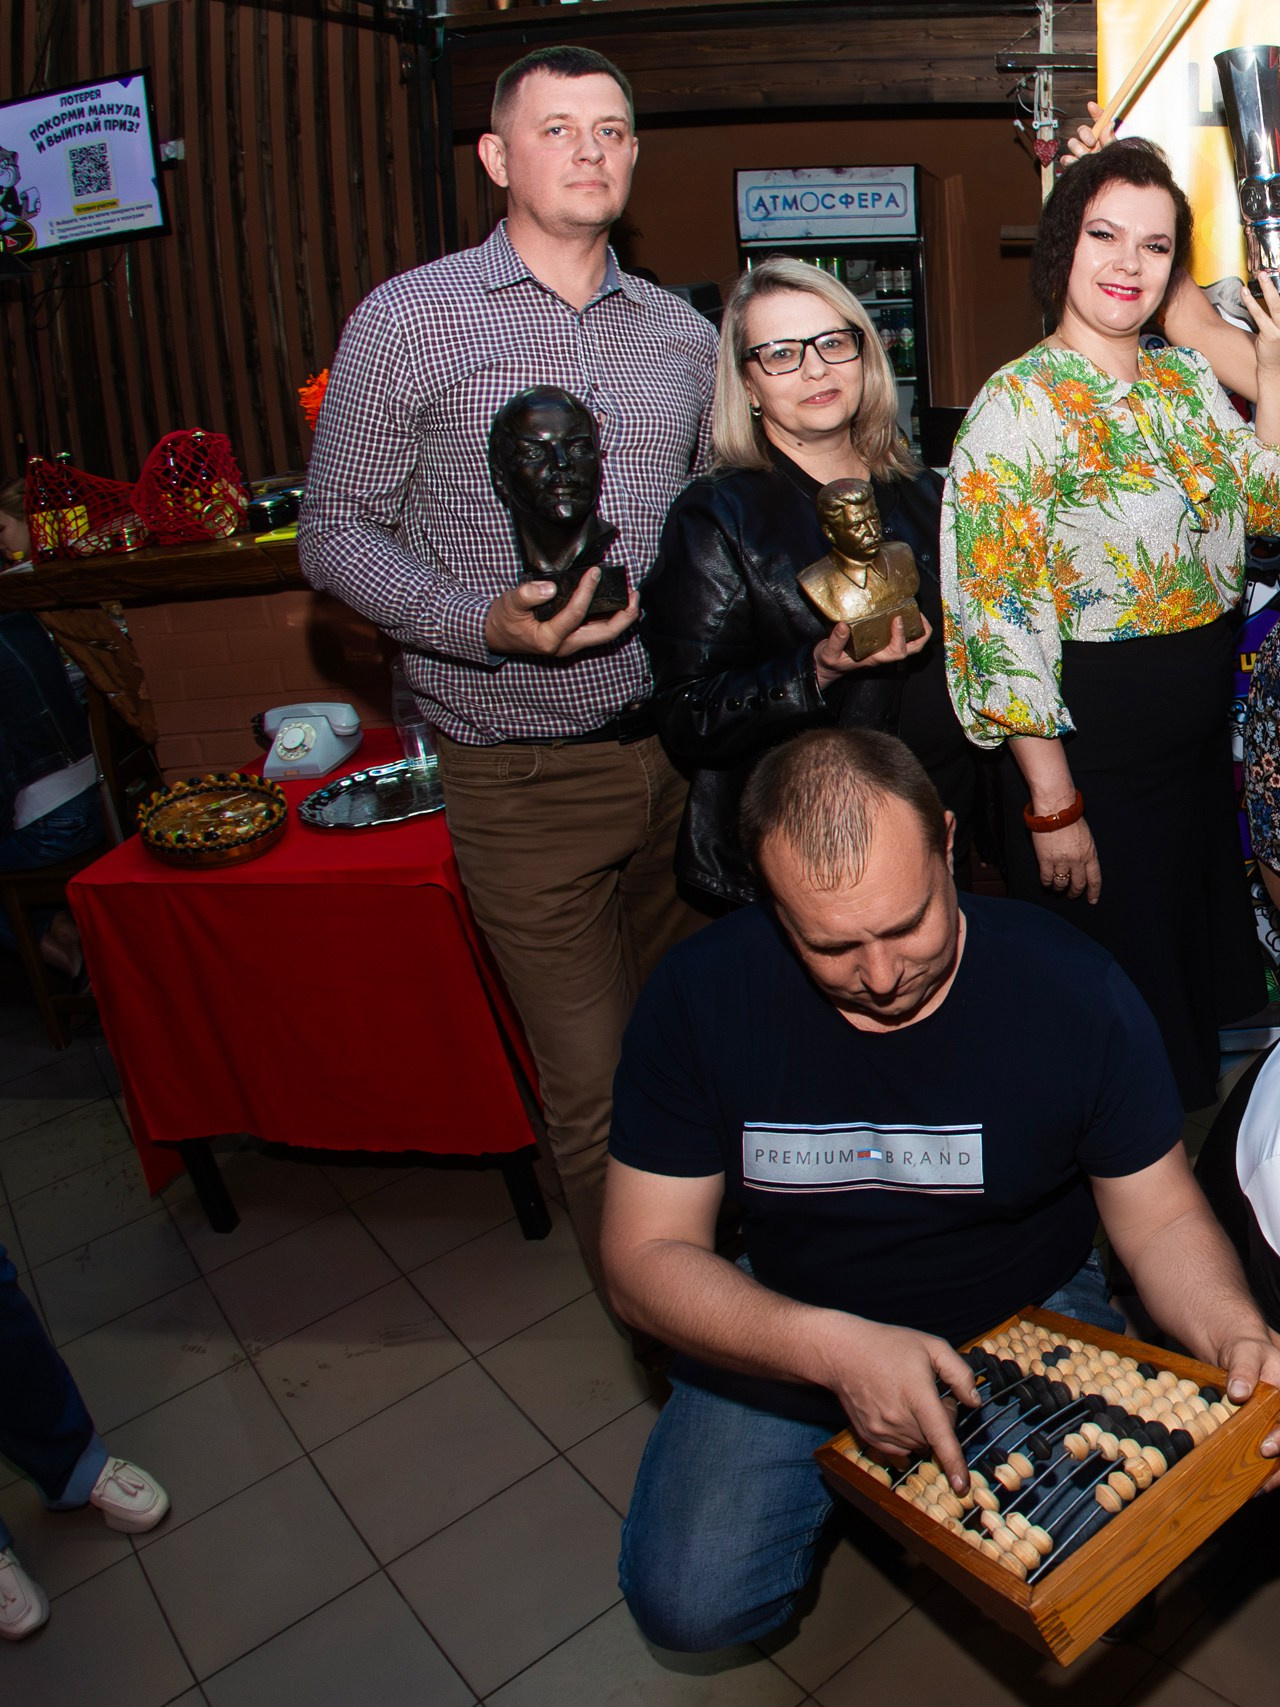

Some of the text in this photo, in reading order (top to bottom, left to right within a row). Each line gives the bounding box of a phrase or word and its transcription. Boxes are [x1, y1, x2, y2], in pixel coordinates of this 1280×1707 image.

[60, 89, 102, 107] ЛОТЕРЕЯ
[29, 104, 141, 141] ПОКОРМИ МАНУЛА
[36, 117, 140, 153] И ВЫИГРАЙ ПРИЗ!
[754, 192, 900, 217] АТМОСФЕРА
[755, 1149, 971, 1167] PREMIUM BRAND
